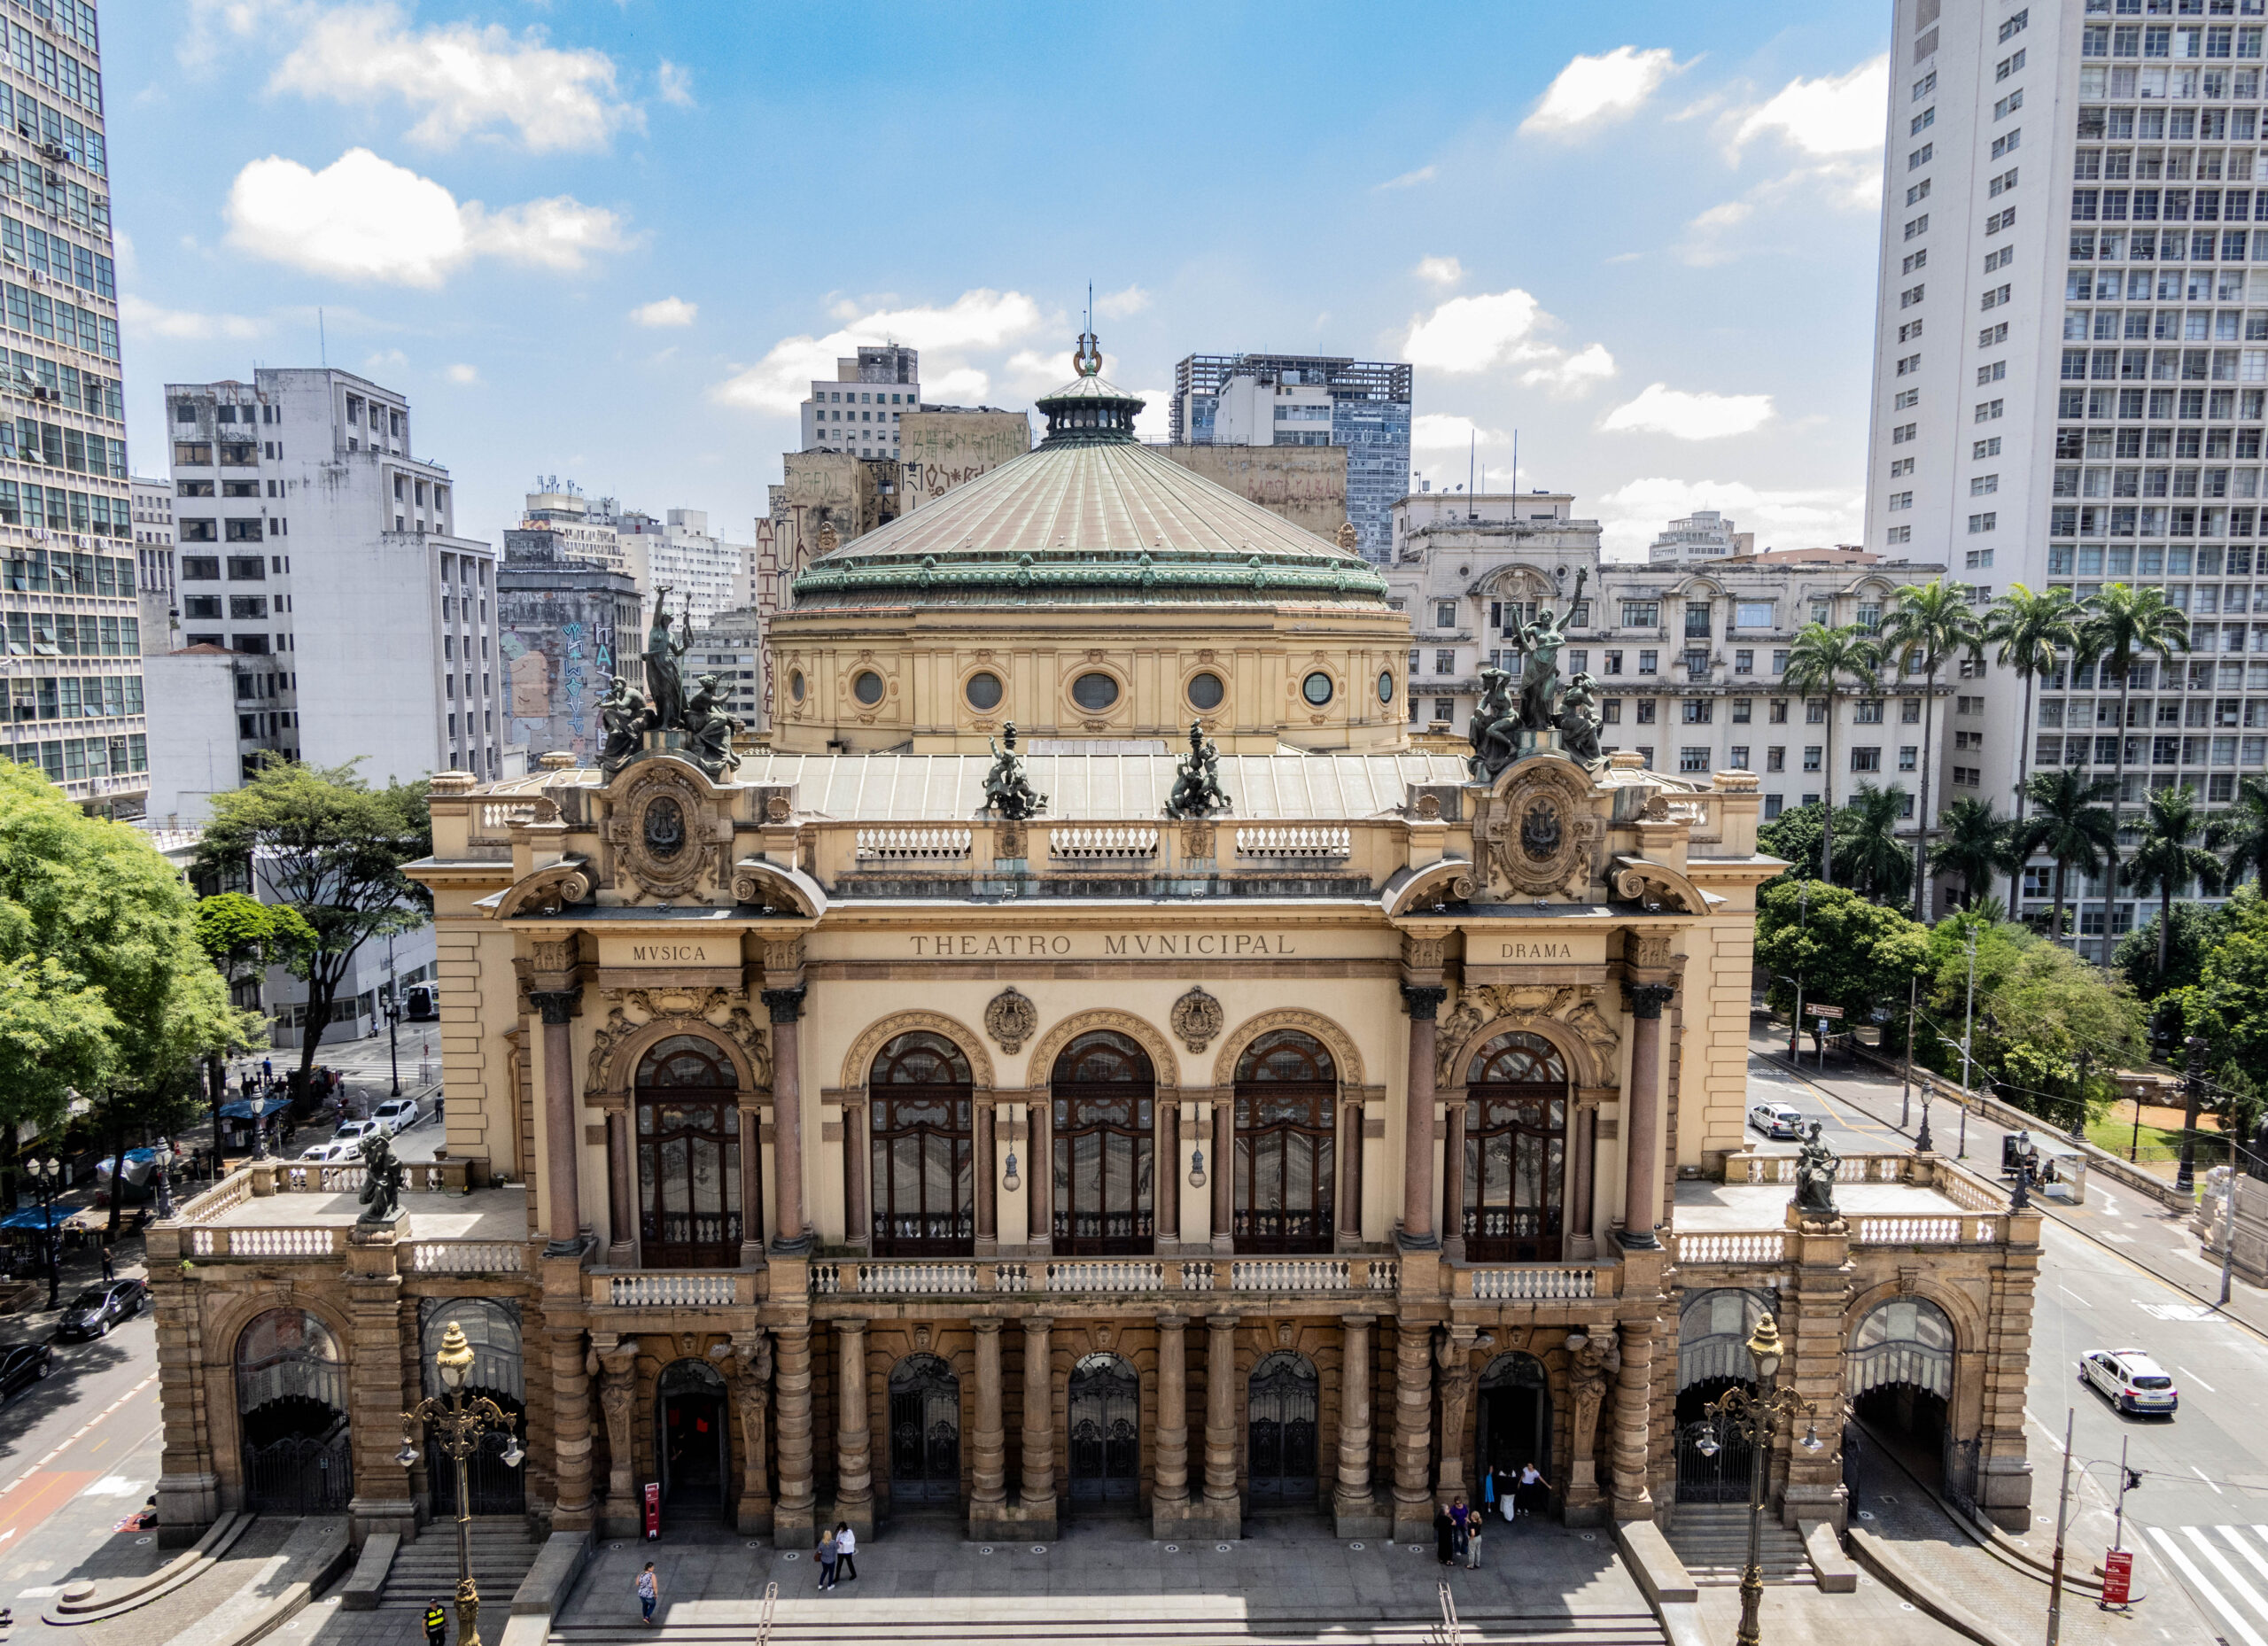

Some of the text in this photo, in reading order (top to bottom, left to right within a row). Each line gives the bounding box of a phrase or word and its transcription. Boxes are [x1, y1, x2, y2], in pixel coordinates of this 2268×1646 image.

[910, 935, 1296, 955] THEATRO MVNICIPAL
[1502, 943, 1572, 958] DRAMA
[633, 946, 706, 960] MVSICA
